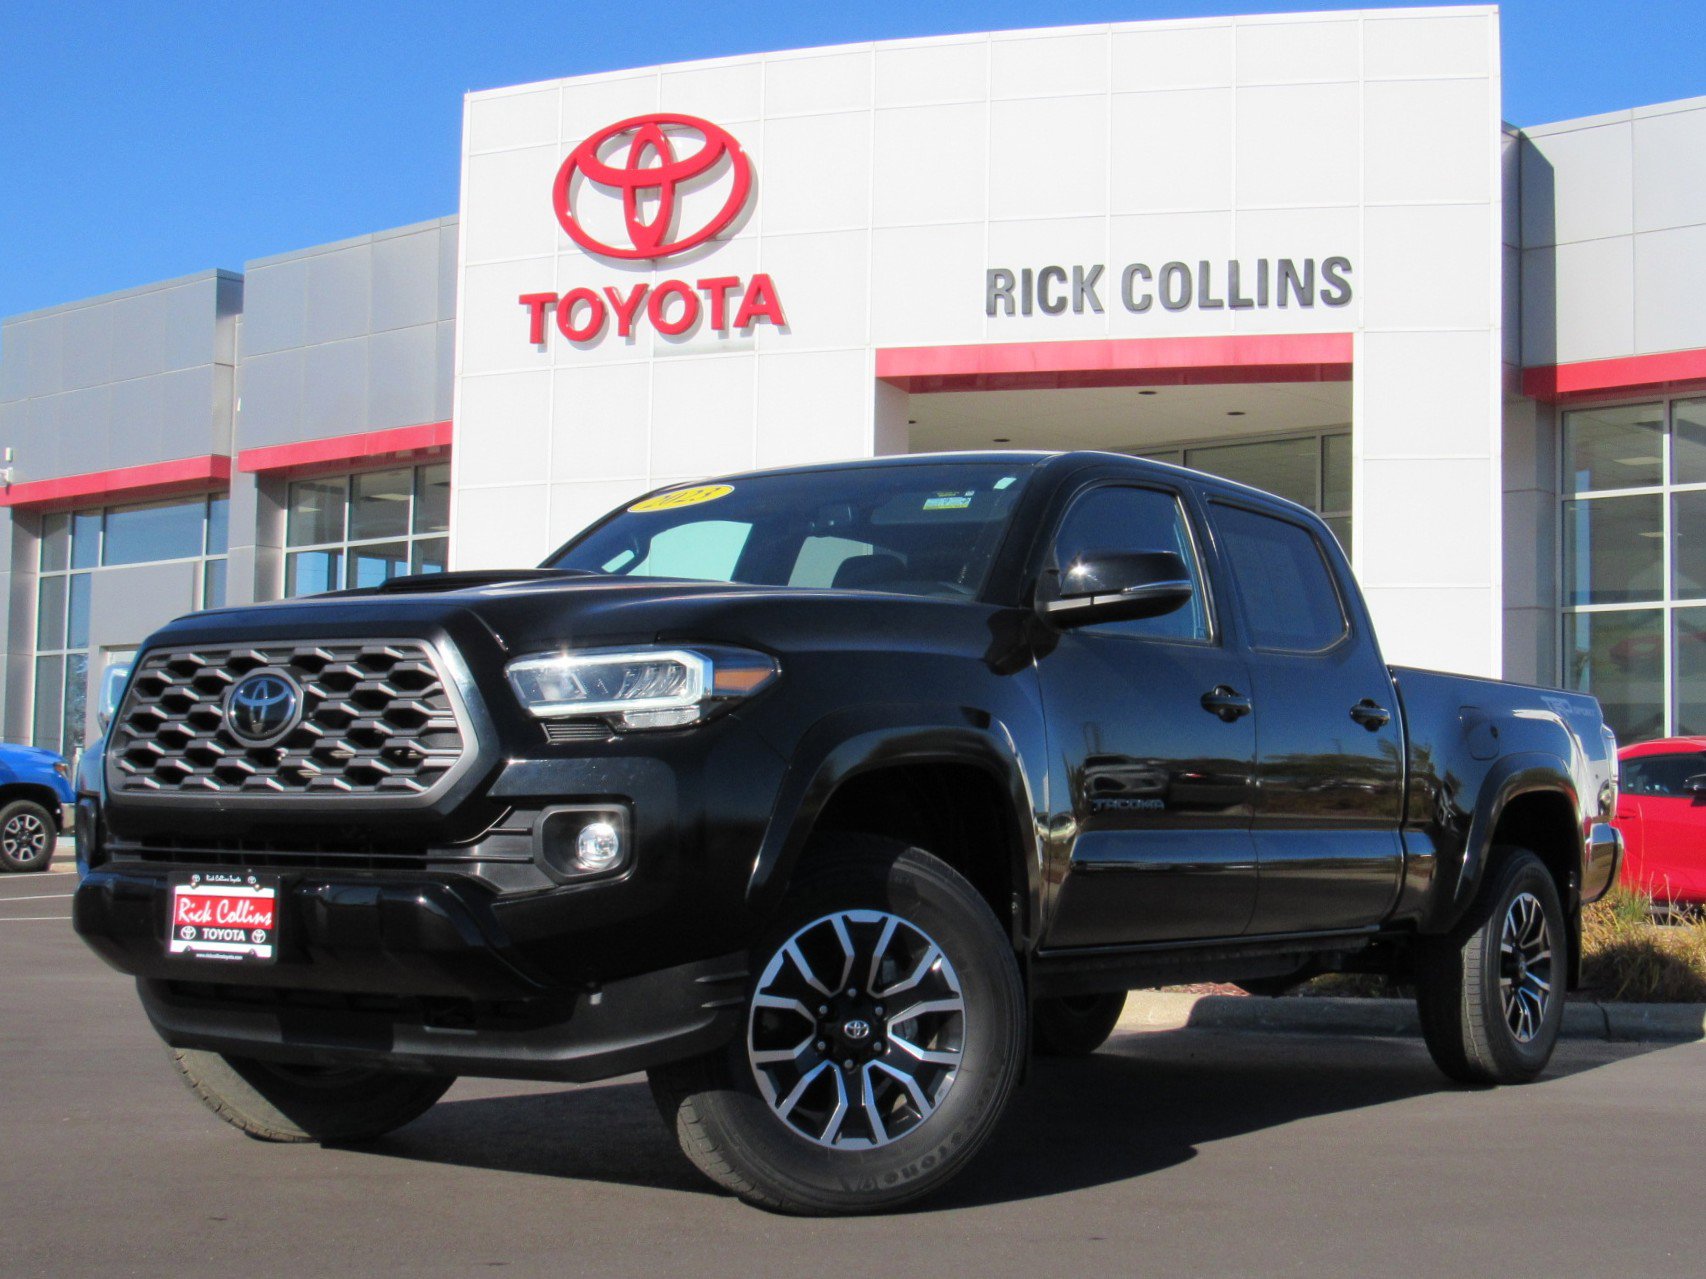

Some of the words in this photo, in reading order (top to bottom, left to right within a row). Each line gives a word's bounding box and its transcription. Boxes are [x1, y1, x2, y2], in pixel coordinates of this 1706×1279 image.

[986, 264, 1105, 316] RICK
[1121, 256, 1352, 314] COLLINS
[519, 273, 785, 344] TOYOTA
[1092, 798, 1165, 810] TACOMA
[178, 897, 213, 924] Rick
[216, 898, 273, 927] Collins
[202, 928, 246, 942] TOYOTA
